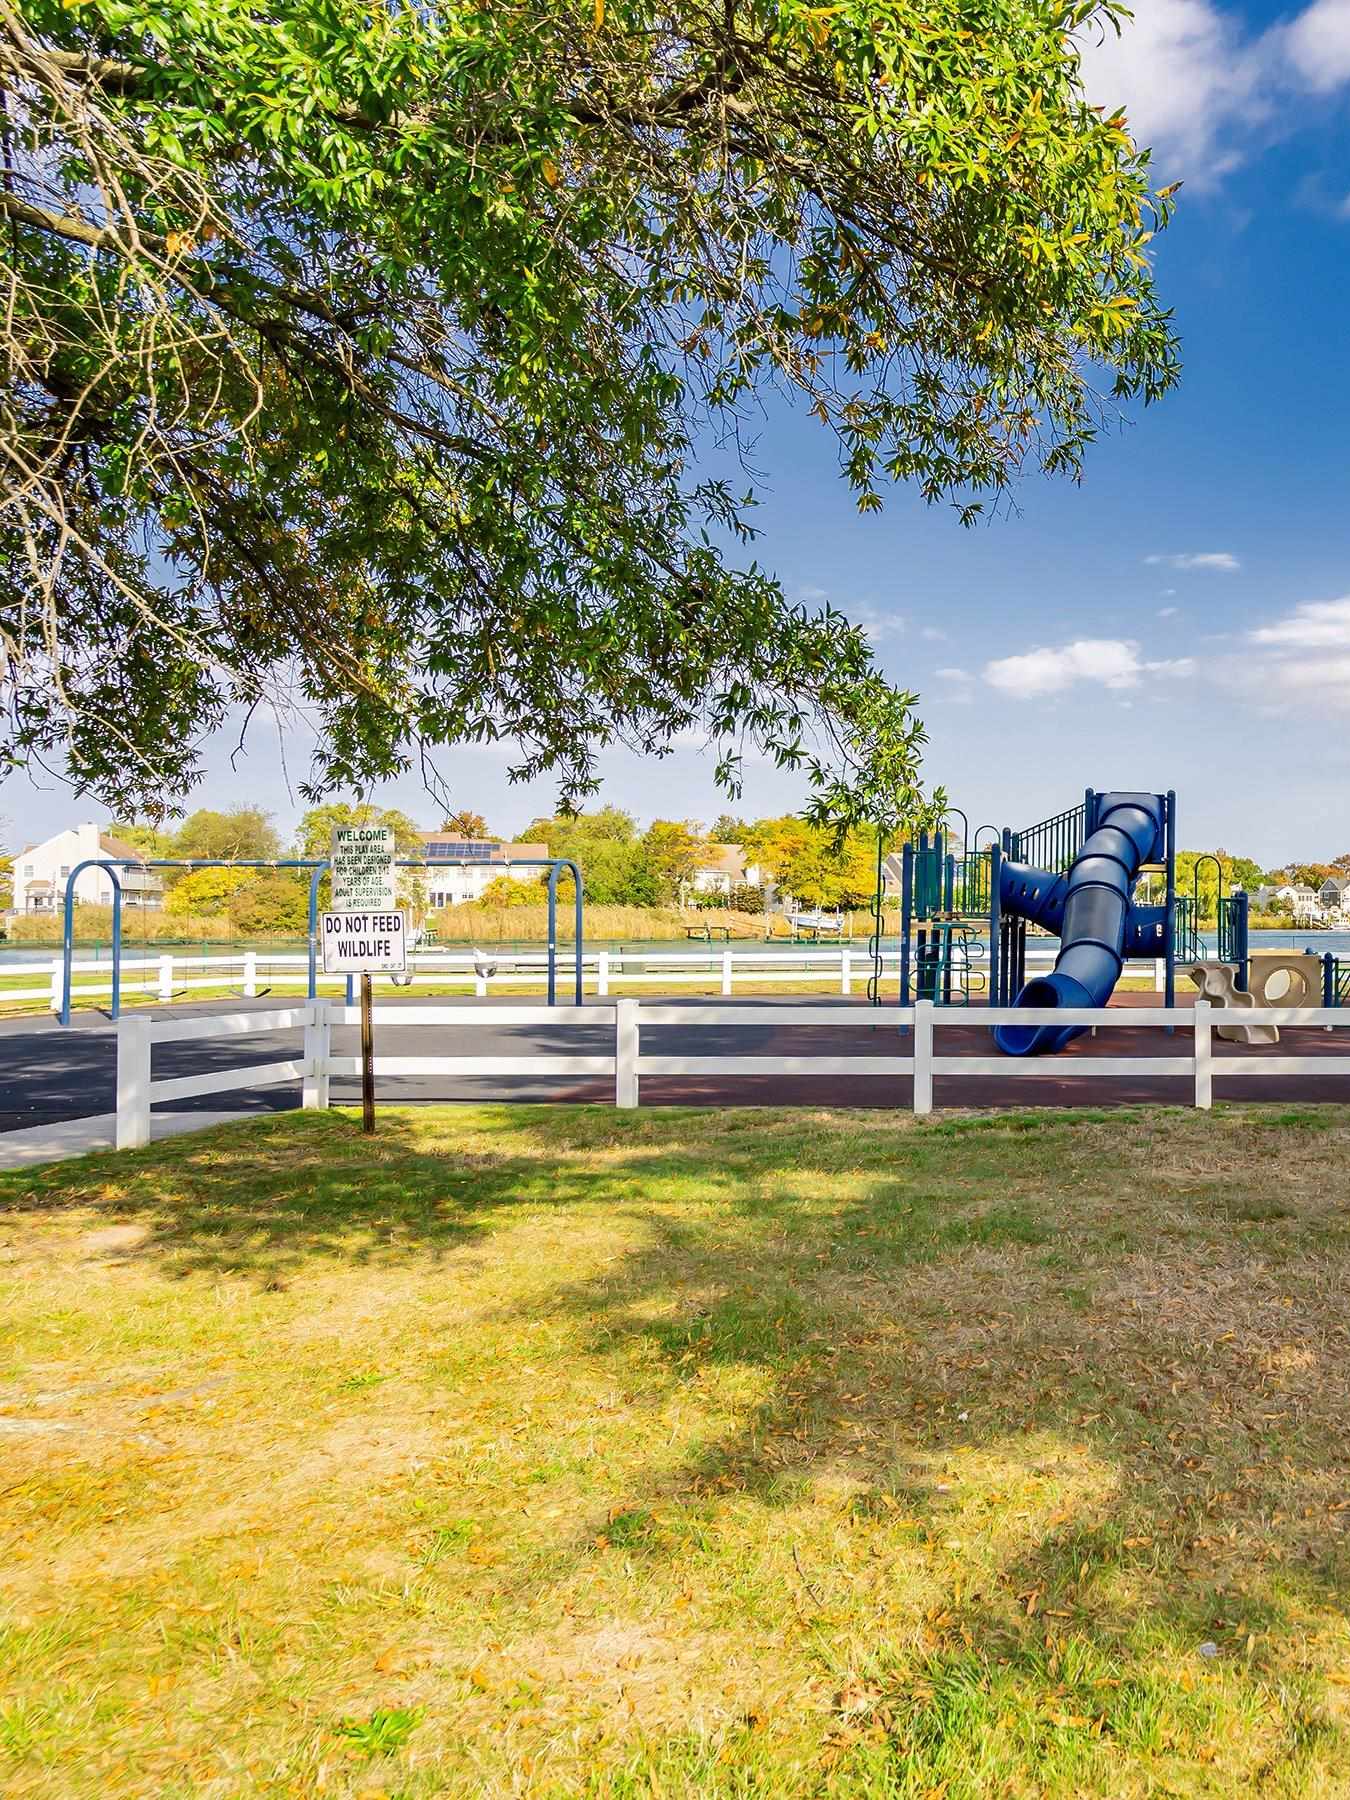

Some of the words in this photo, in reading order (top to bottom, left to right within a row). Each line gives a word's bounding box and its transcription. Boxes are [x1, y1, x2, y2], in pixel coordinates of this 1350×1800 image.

[336, 830, 387, 841] WELCOME
[340, 845, 354, 854] THIS
[355, 845, 369, 854] PLAY
[370, 845, 385, 853] AREA
[334, 856, 346, 865] HAS
[347, 856, 362, 865] BEEN
[363, 855, 392, 865] DESIGNED
[336, 866, 348, 876] FOR
[349, 866, 377, 876] CHILDREN
[343, 877, 362, 886] YEARS
[363, 877, 370, 886] OF
[335, 887, 353, 897] ADULT
[354, 887, 392, 896] SUPERVISION
[353, 898, 382, 907] REQUIRED
[326, 917, 342, 933] DO
[346, 915, 369, 933] NOT
[372, 915, 401, 932] FEED
[338, 940, 391, 957] WILDLIFE
